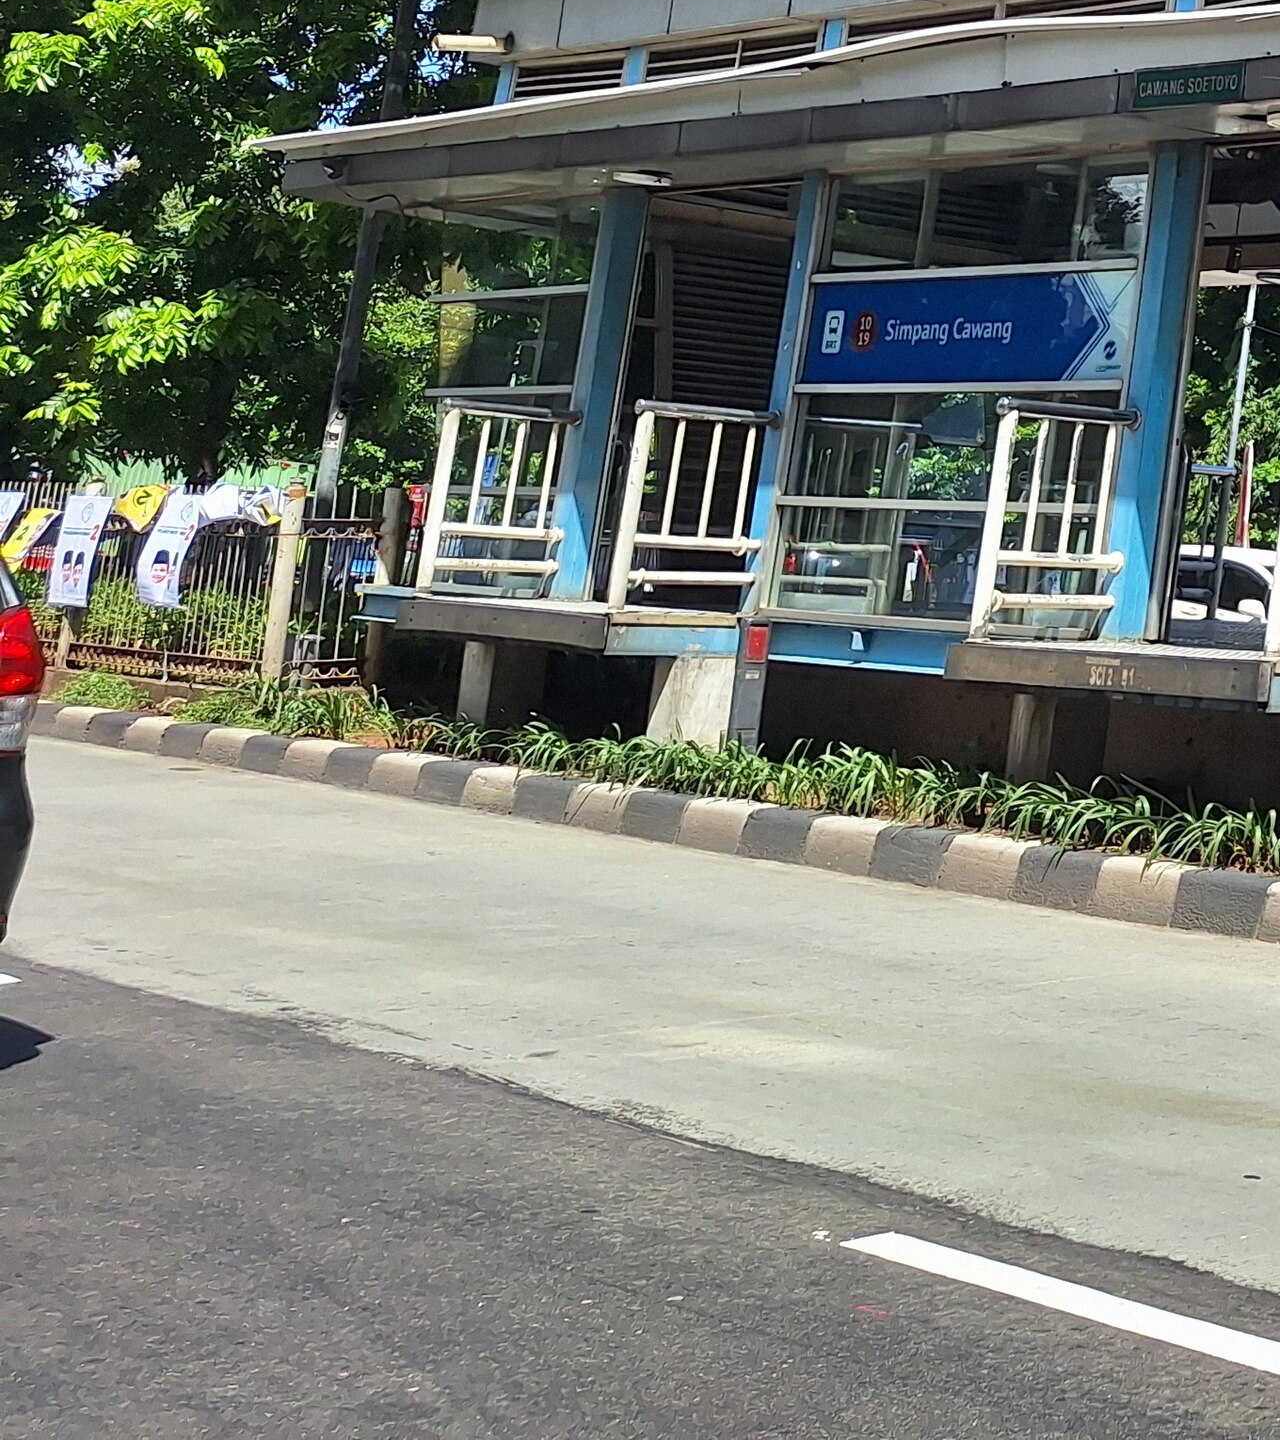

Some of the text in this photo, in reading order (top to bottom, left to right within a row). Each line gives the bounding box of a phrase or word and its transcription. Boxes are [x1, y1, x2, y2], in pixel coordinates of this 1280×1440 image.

[1139, 74, 1239, 98] CAWANG SOETOYO
[859, 315, 873, 331] 10
[884, 317, 1013, 346] Simpang Cawang
[857, 331, 871, 347] 19
[90, 524, 100, 541] 2
[184, 523, 195, 541] 2
